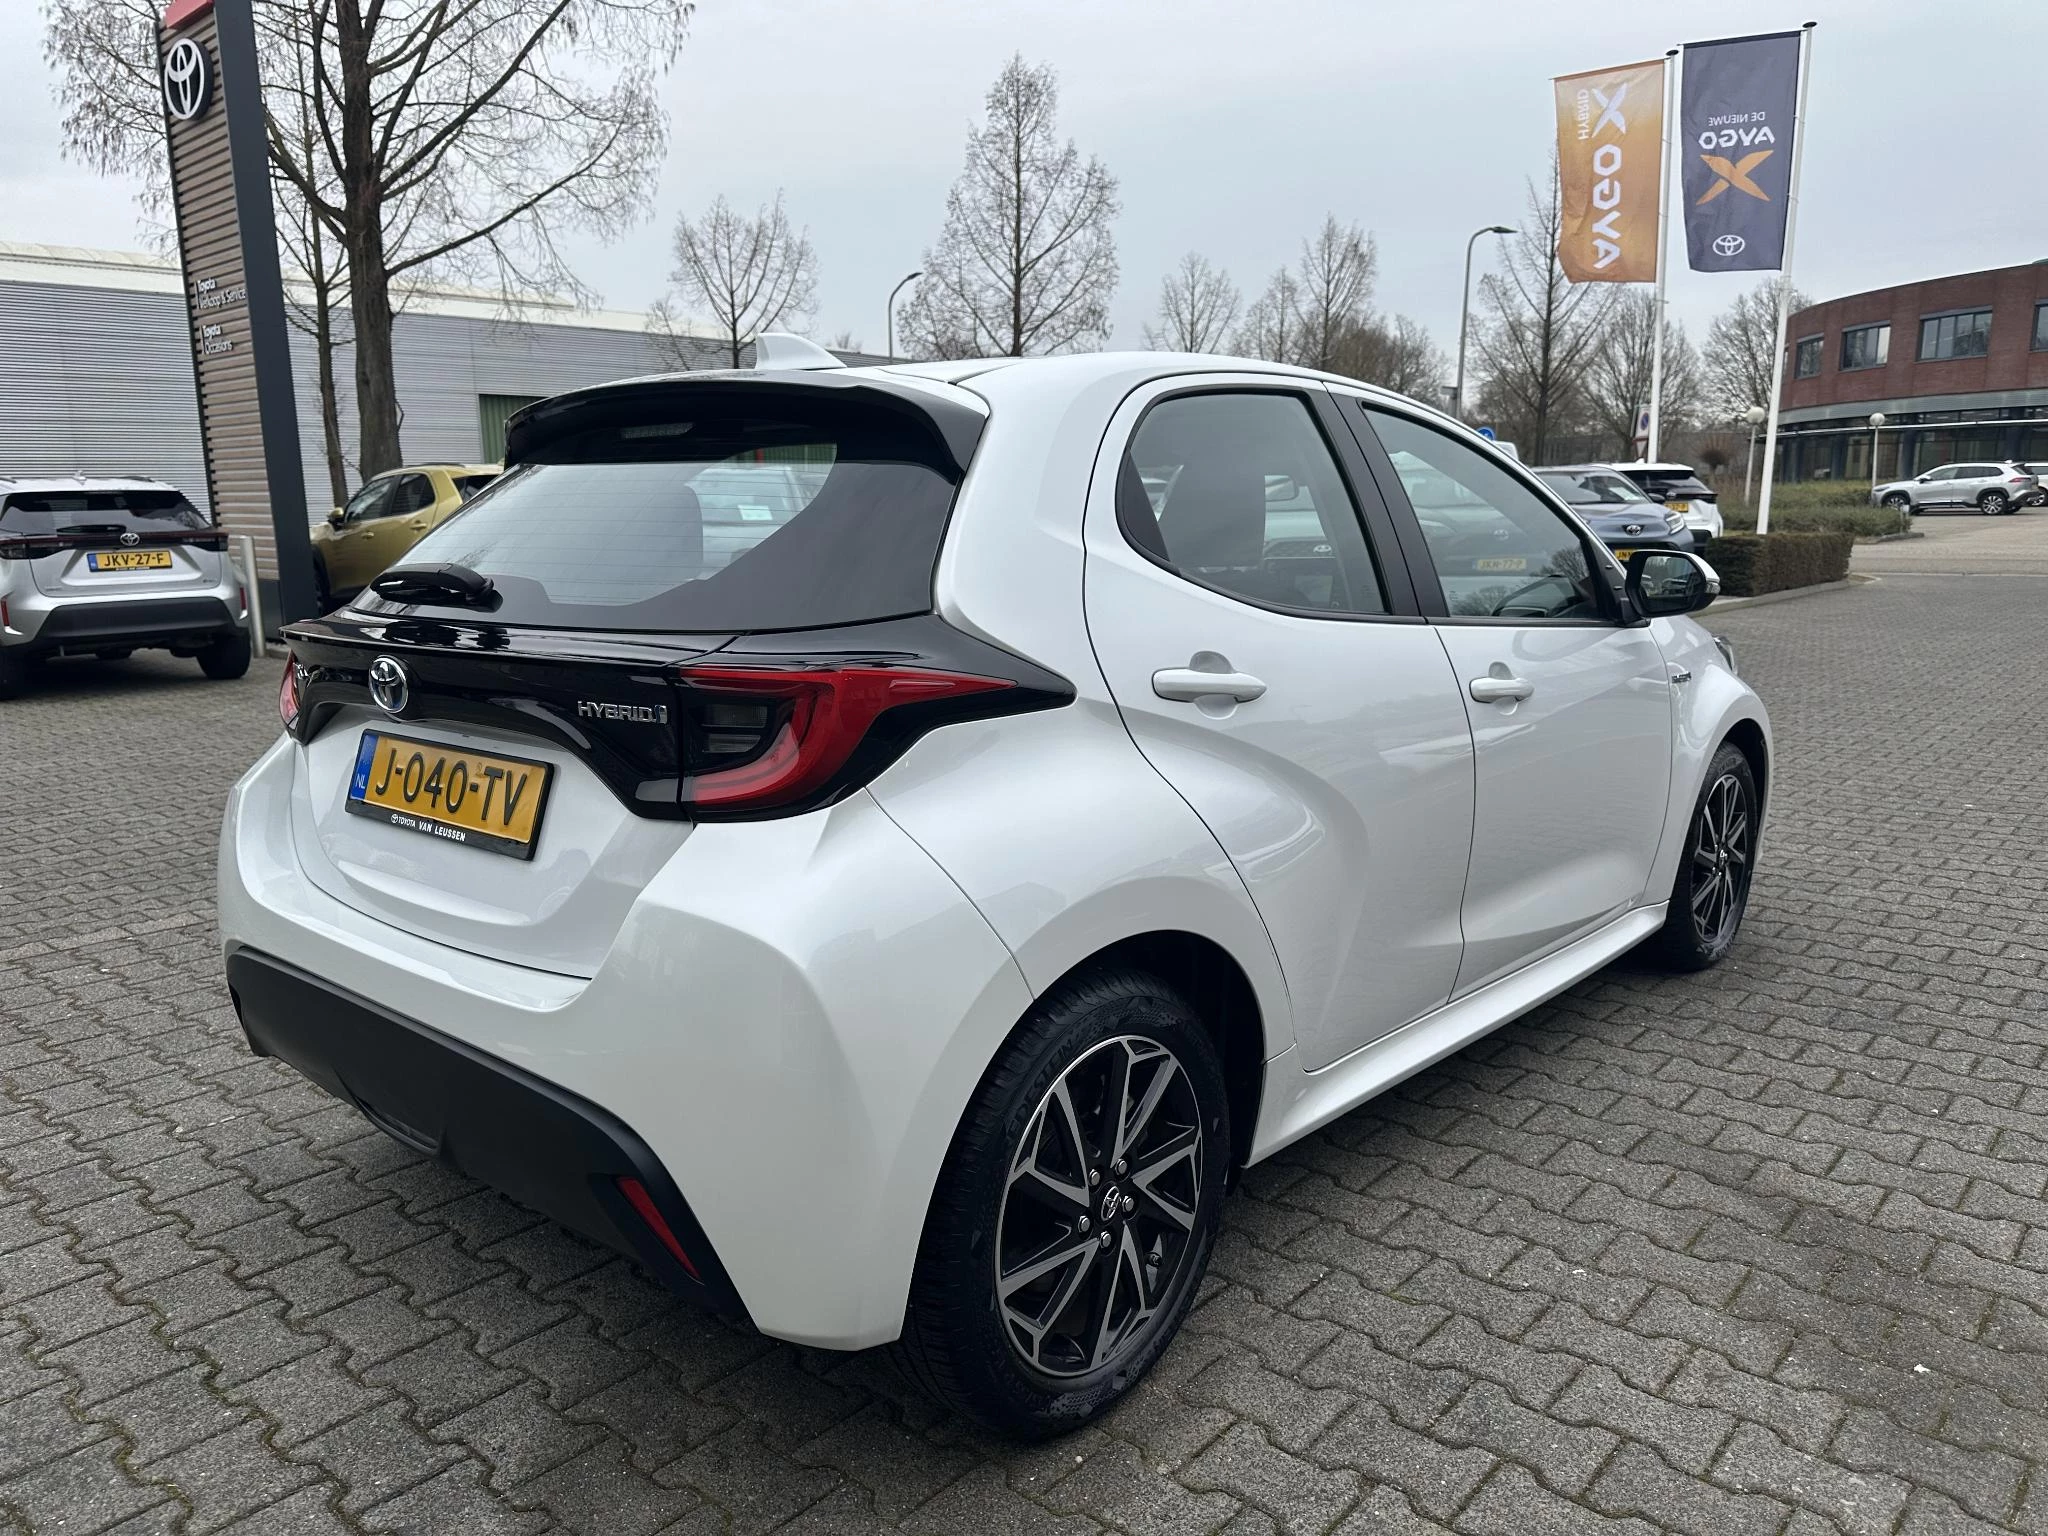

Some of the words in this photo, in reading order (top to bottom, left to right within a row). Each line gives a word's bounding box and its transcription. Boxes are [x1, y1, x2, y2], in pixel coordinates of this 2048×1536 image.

[197, 277, 216, 294] Toyota
[225, 287, 246, 303] Service
[202, 324, 221, 341] Toyota
[204, 340, 233, 355] Occasions
[104, 553, 165, 567] JKV-27-F
[577, 700, 653, 722] HYBRID
[354, 773, 366, 790] NL
[375, 747, 528, 826] J-040-TV
[397, 815, 416, 828] TOYOTA
[418, 820, 432, 833] VAN
[434, 825, 466, 842] LEUSSEN
